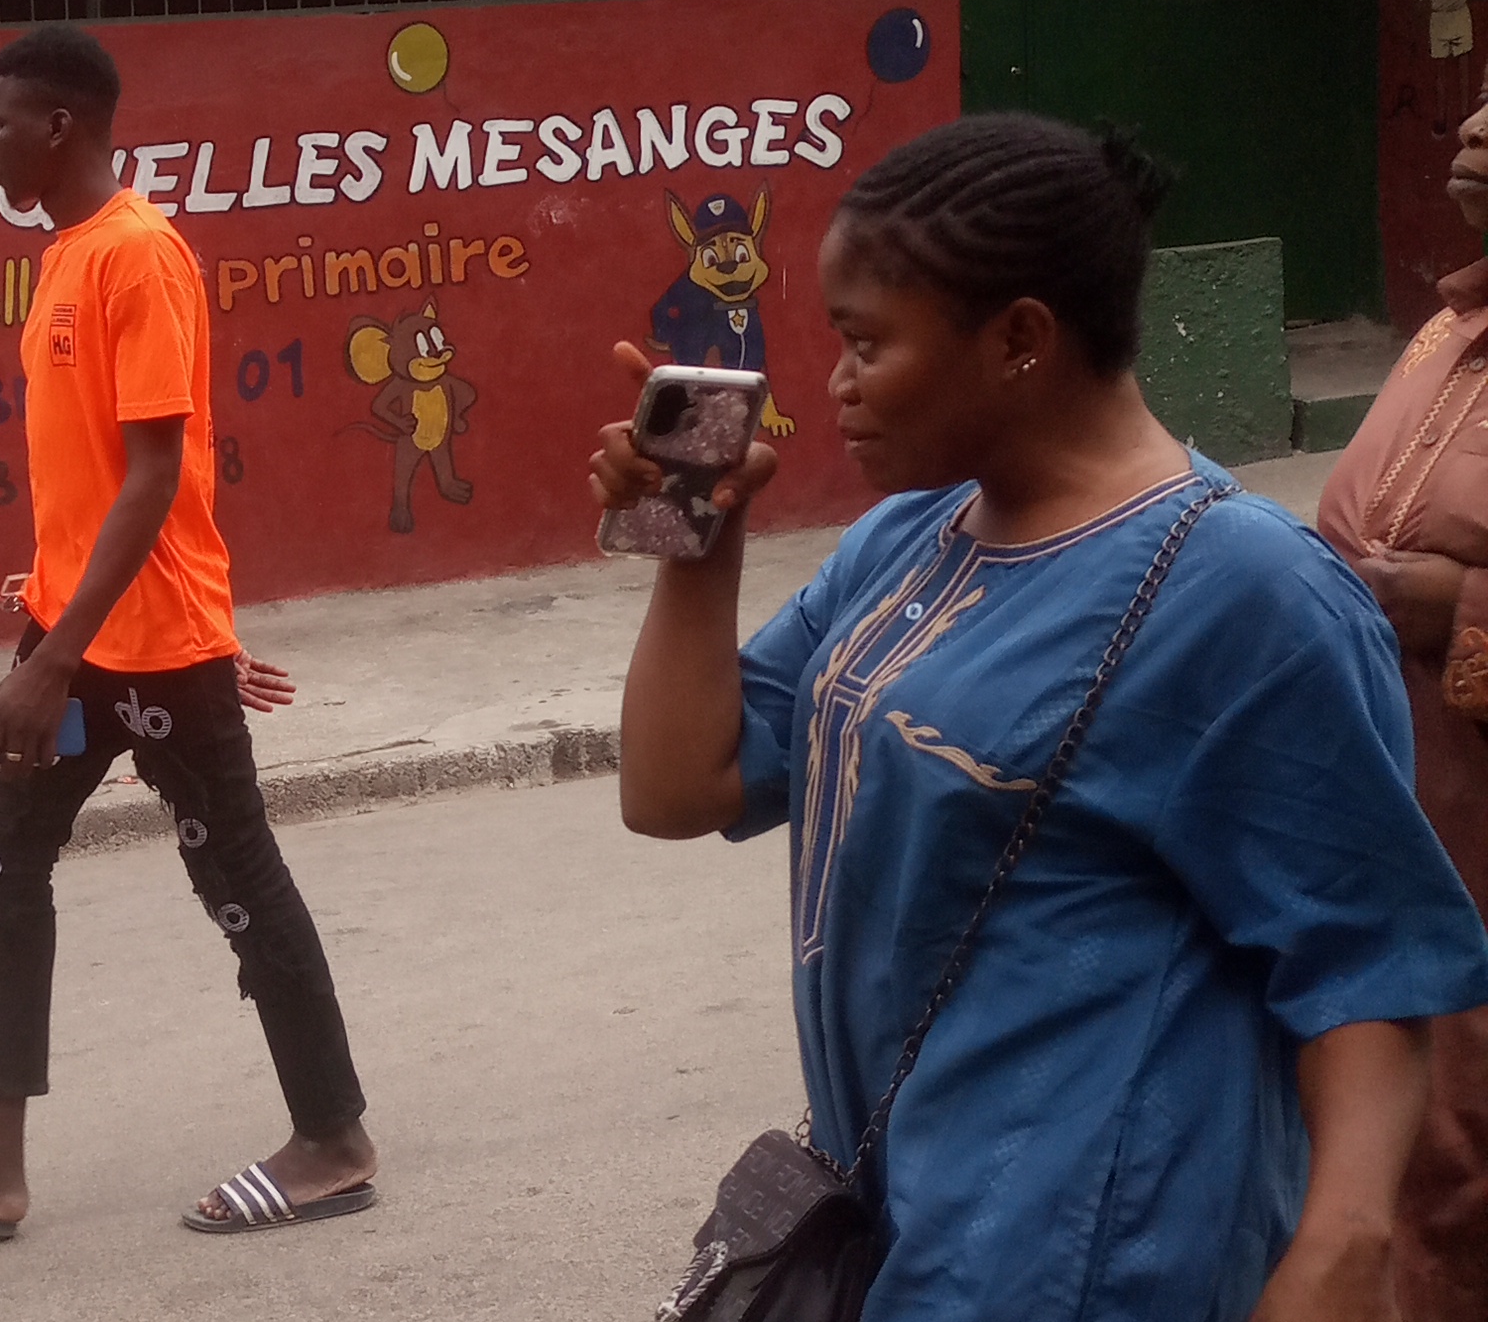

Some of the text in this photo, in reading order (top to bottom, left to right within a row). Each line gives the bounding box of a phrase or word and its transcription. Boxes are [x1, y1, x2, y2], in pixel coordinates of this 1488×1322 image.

[408, 94, 851, 193] MESANGES
[218, 222, 530, 312] primaire
[52, 334, 72, 355] HG
[237, 338, 304, 402] 01
[220, 436, 244, 485] 8
